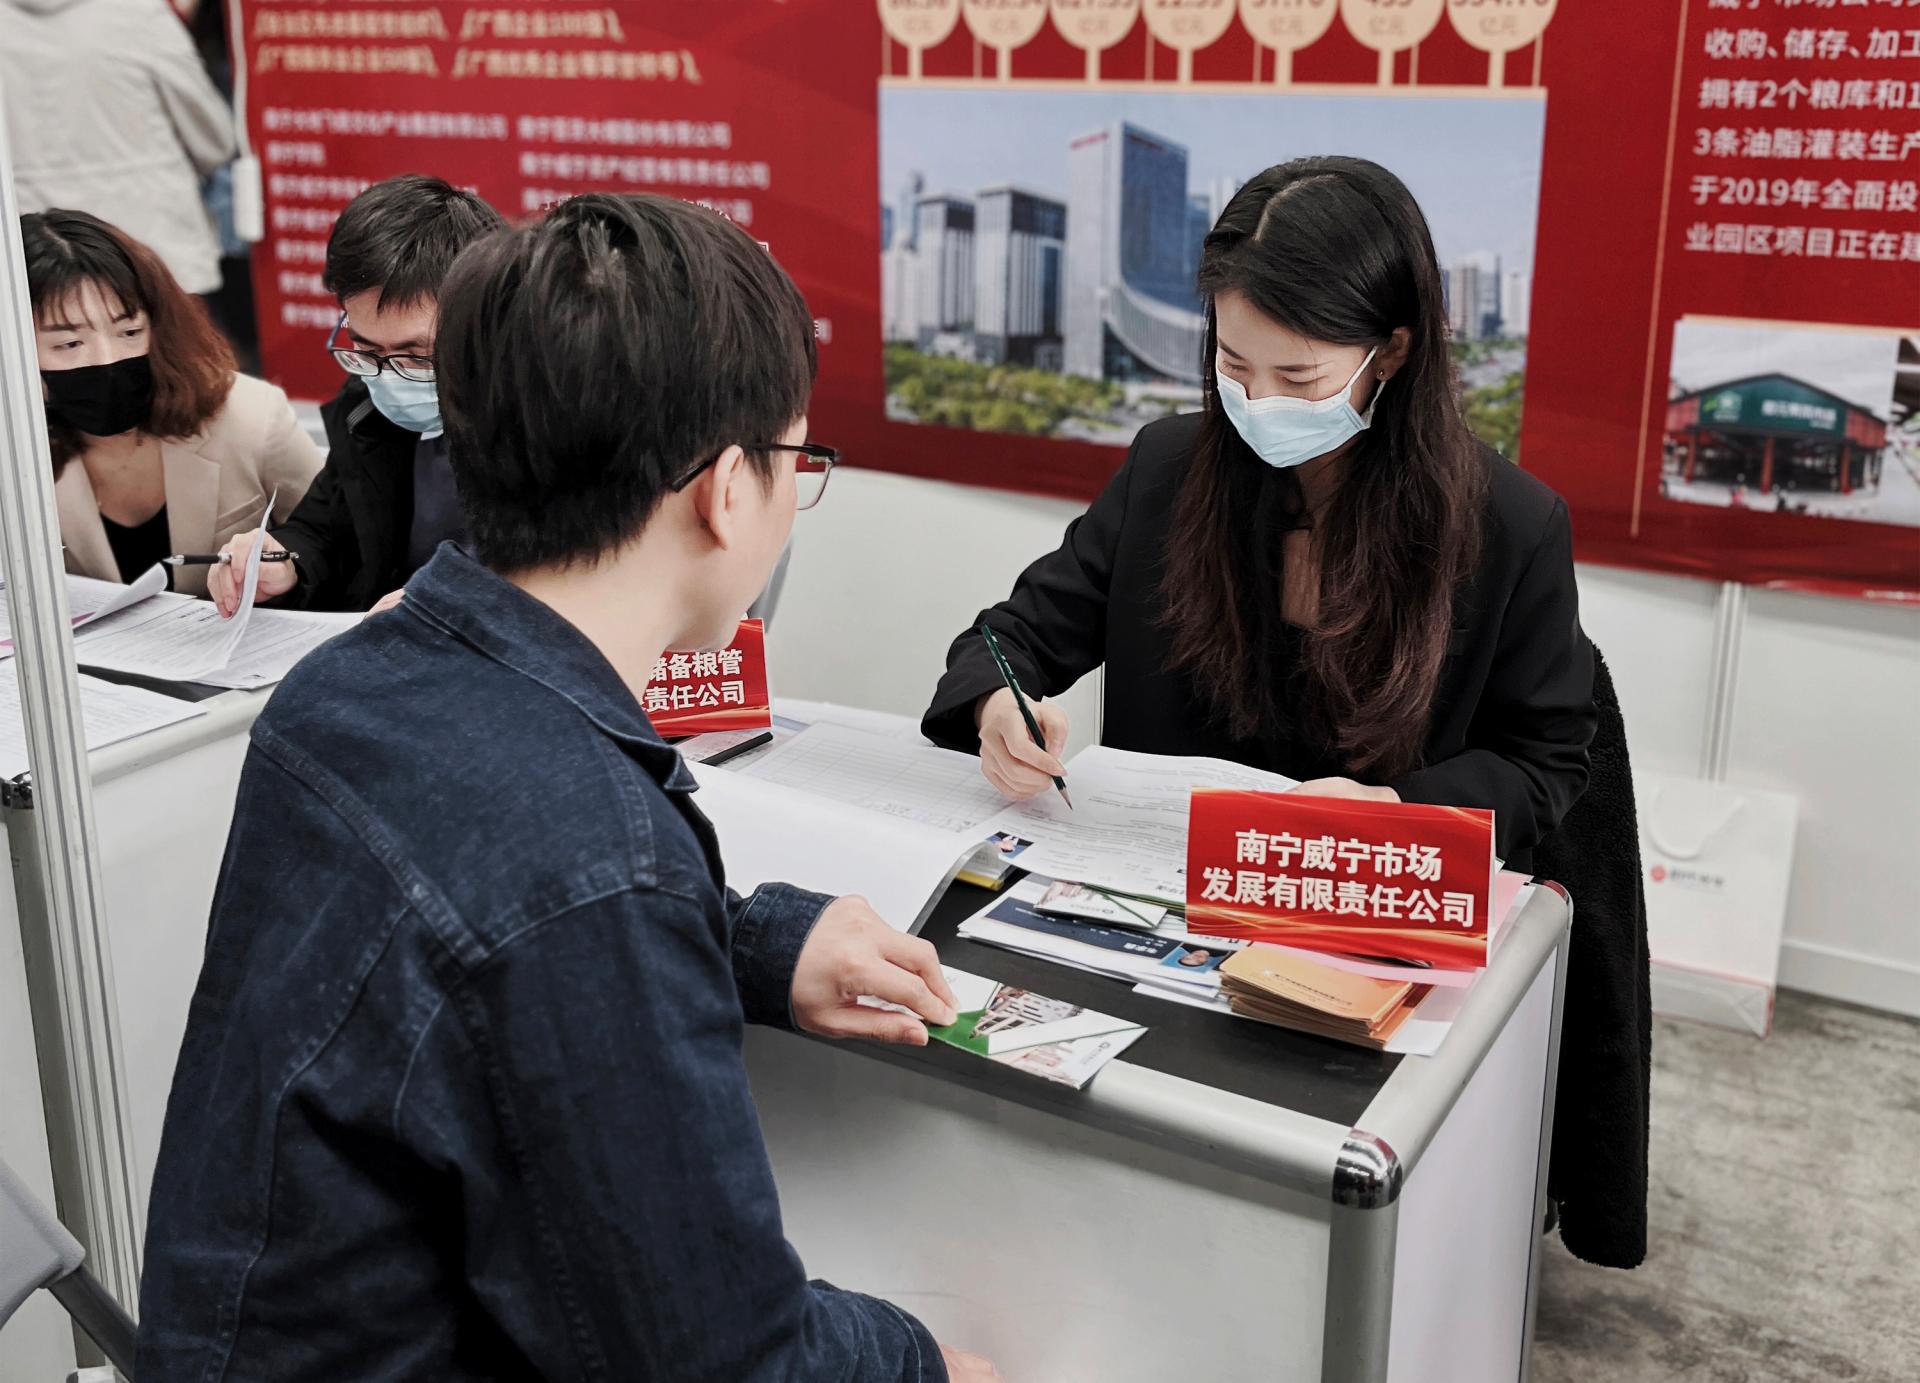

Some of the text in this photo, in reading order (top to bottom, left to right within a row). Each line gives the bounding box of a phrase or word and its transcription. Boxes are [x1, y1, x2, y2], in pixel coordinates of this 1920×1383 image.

[1690, 175, 1919, 213] 于2019年全面投
[641, 680, 745, 713] 责任公司
[1234, 829, 1443, 883] 南宁威宁市场
[1200, 866, 1475, 928] 发展有限责任公司
